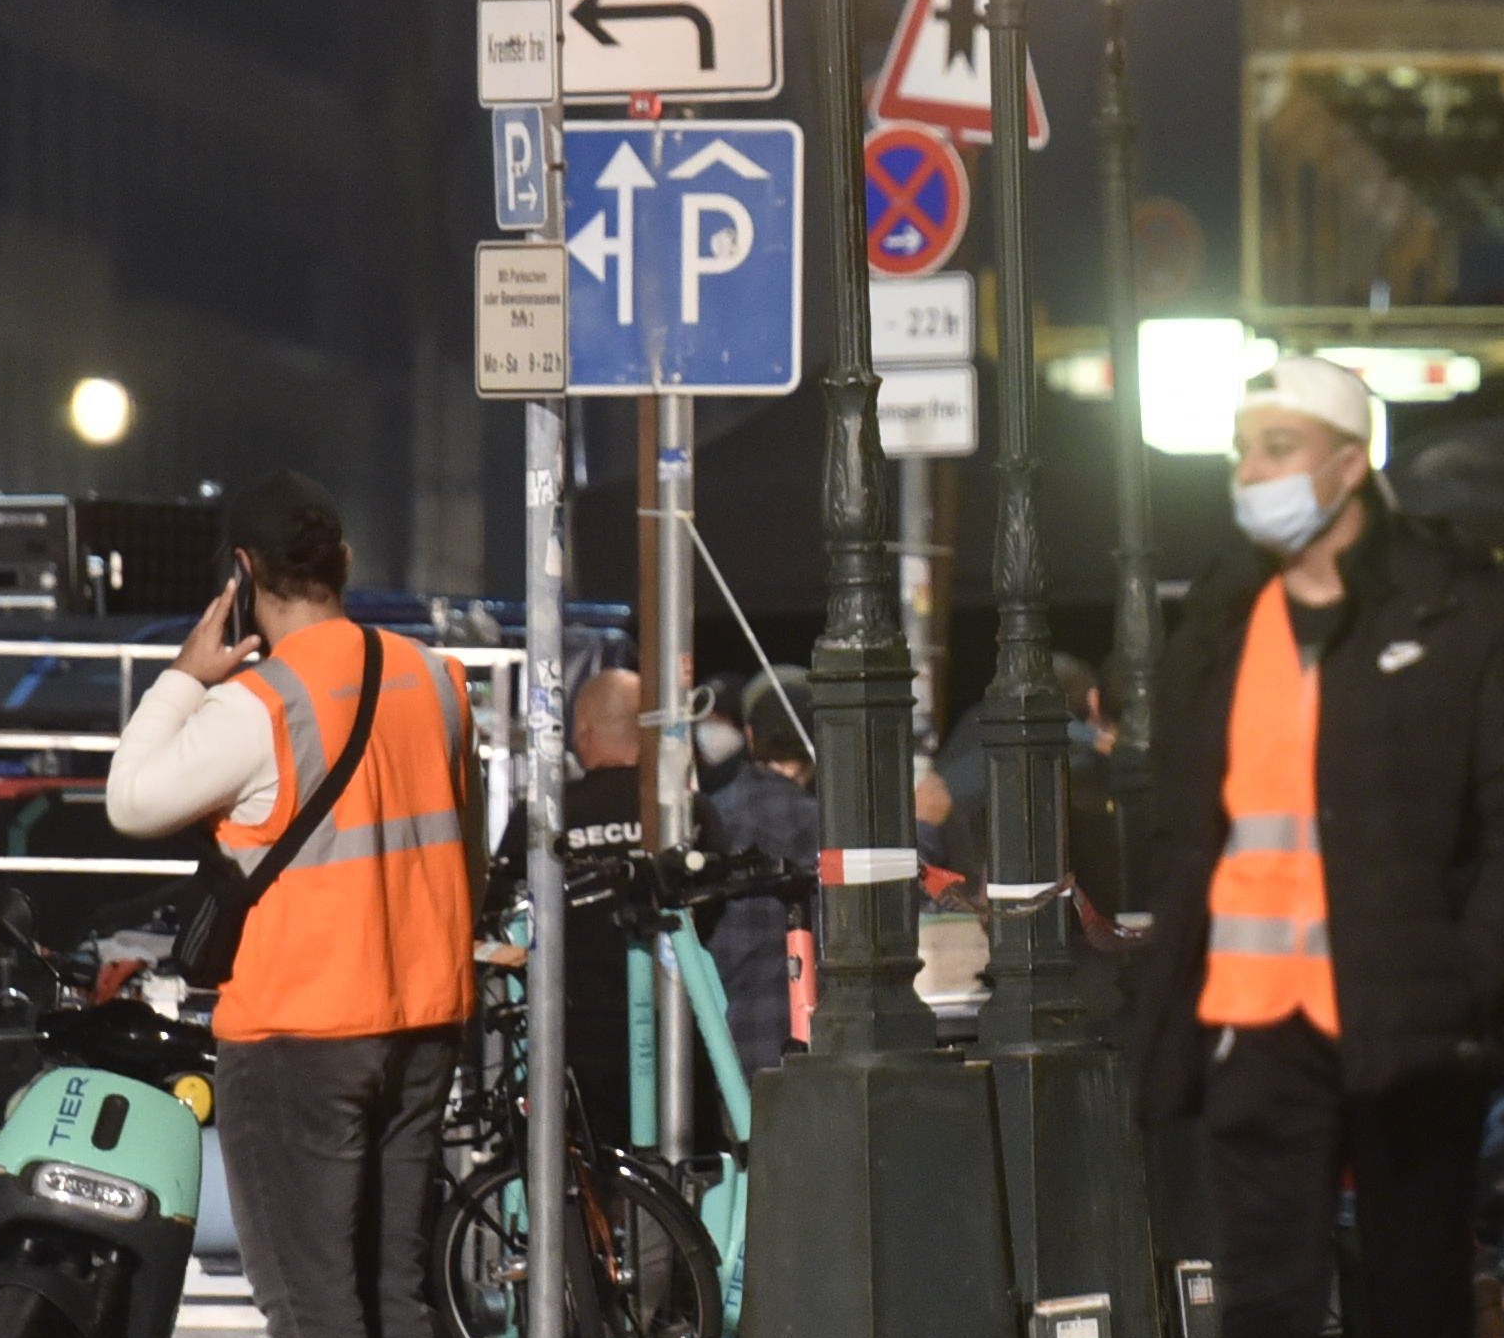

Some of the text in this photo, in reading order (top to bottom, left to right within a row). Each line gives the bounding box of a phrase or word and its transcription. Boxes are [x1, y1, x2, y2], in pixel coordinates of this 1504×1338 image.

[504, 121, 532, 211] P
[680, 191, 755, 325] P
[48, 1075, 90, 1147] TIER
